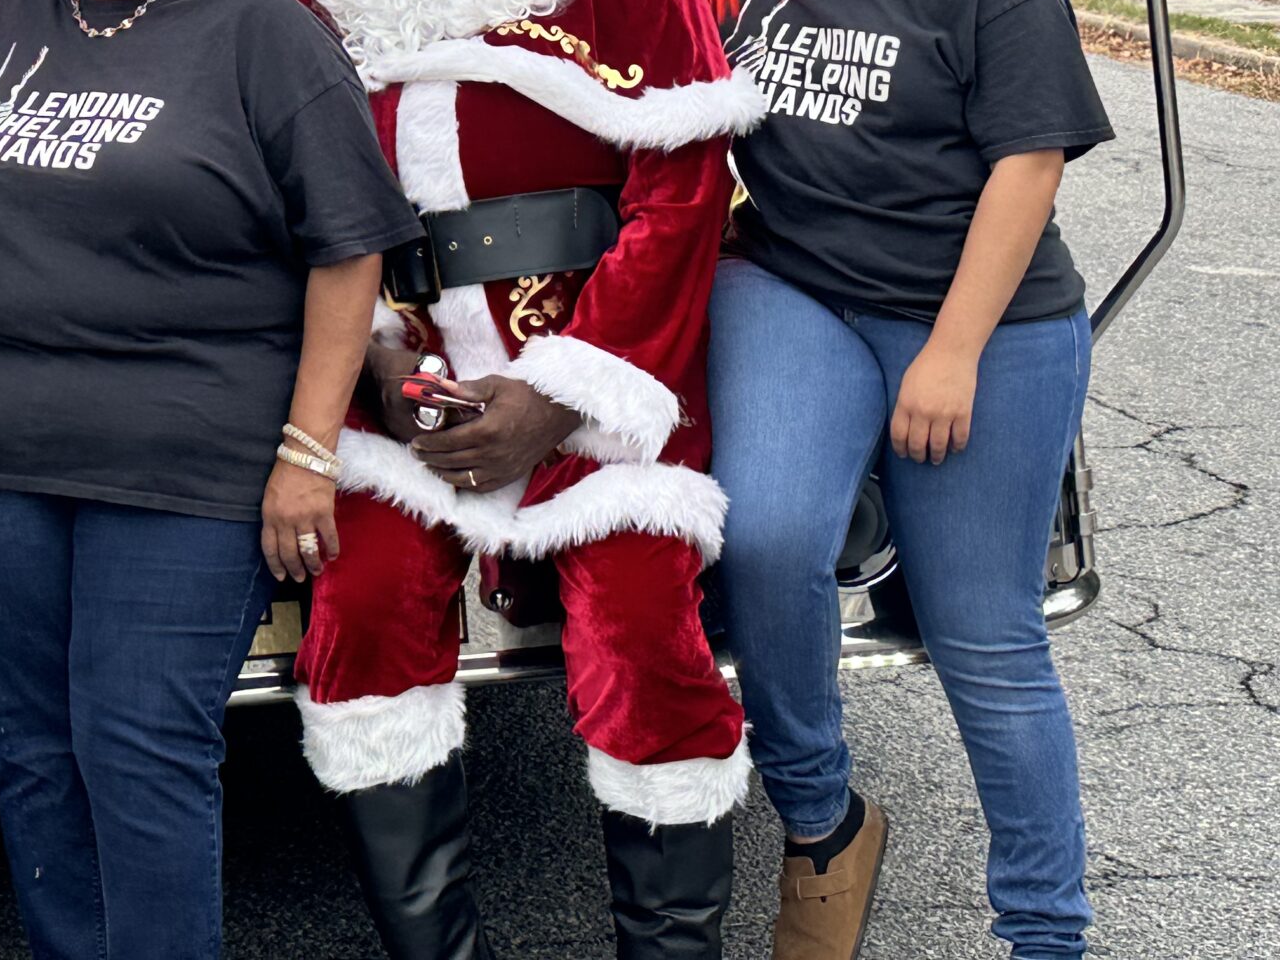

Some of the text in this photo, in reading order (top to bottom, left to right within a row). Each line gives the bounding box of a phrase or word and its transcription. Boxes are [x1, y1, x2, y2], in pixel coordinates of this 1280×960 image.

[771, 23, 901, 68] LENDING
[760, 50, 892, 103] HELPING
[17, 91, 165, 122] LENDING
[757, 81, 863, 126] HANDS
